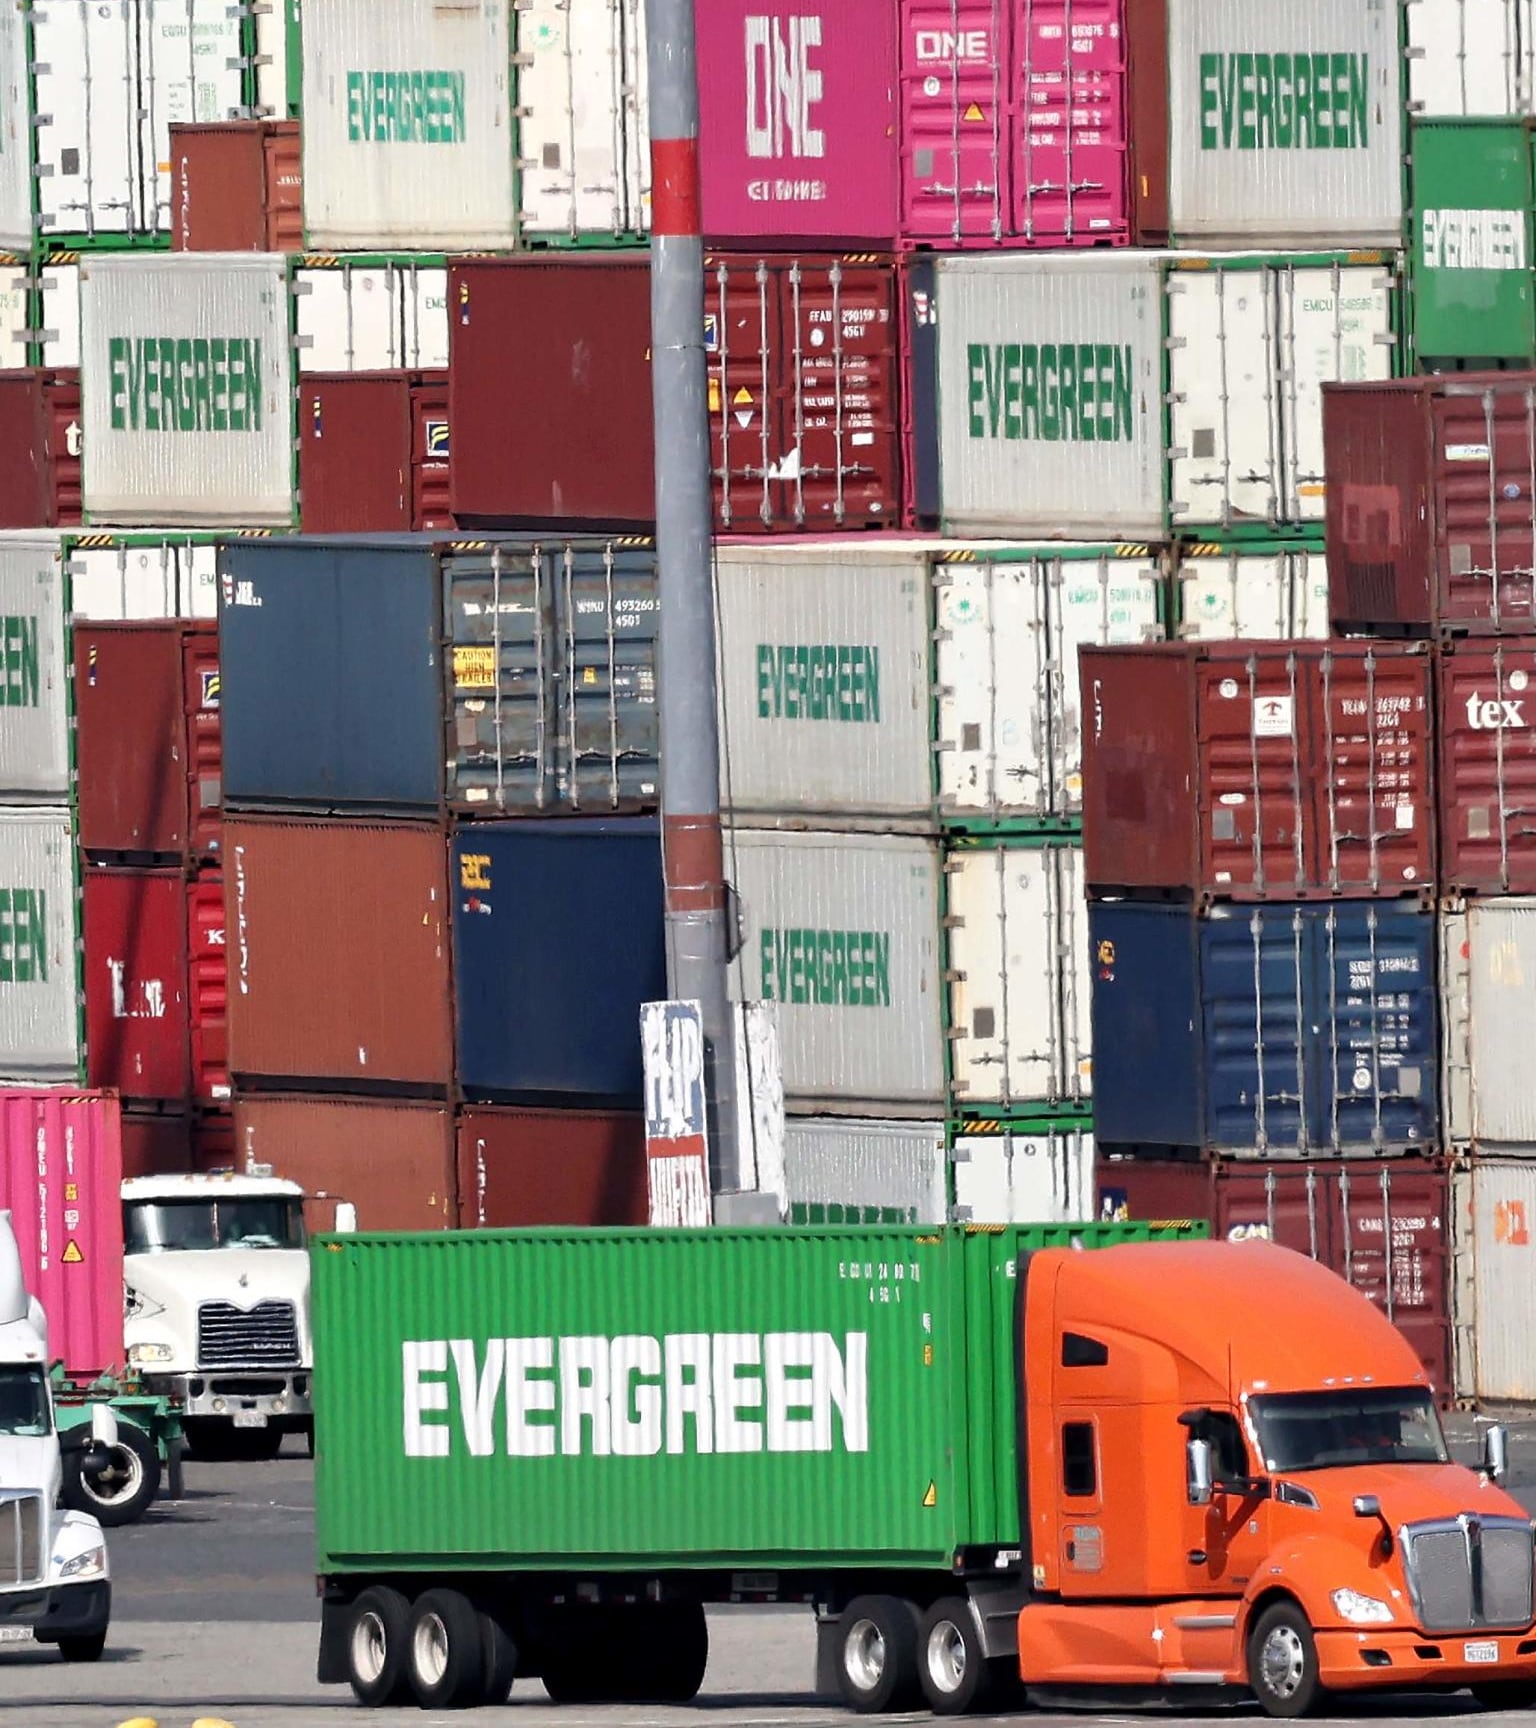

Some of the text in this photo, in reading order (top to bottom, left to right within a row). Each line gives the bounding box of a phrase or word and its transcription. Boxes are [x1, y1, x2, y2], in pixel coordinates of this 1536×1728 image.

[745, 15, 825, 157] ONE
[916, 30, 987, 60] ONE
[1200, 53, 1368, 149] EVERGREEN
[110, 337, 262, 431] EVERGREEN
[967, 343, 1133, 441] EVERGREEN
[757, 644, 880, 722] EVERGREEN
[1466, 691, 1526, 730] tex
[761, 928, 891, 1006] EVERGREEN
[401, 1331, 870, 1458] EVERGREEN
